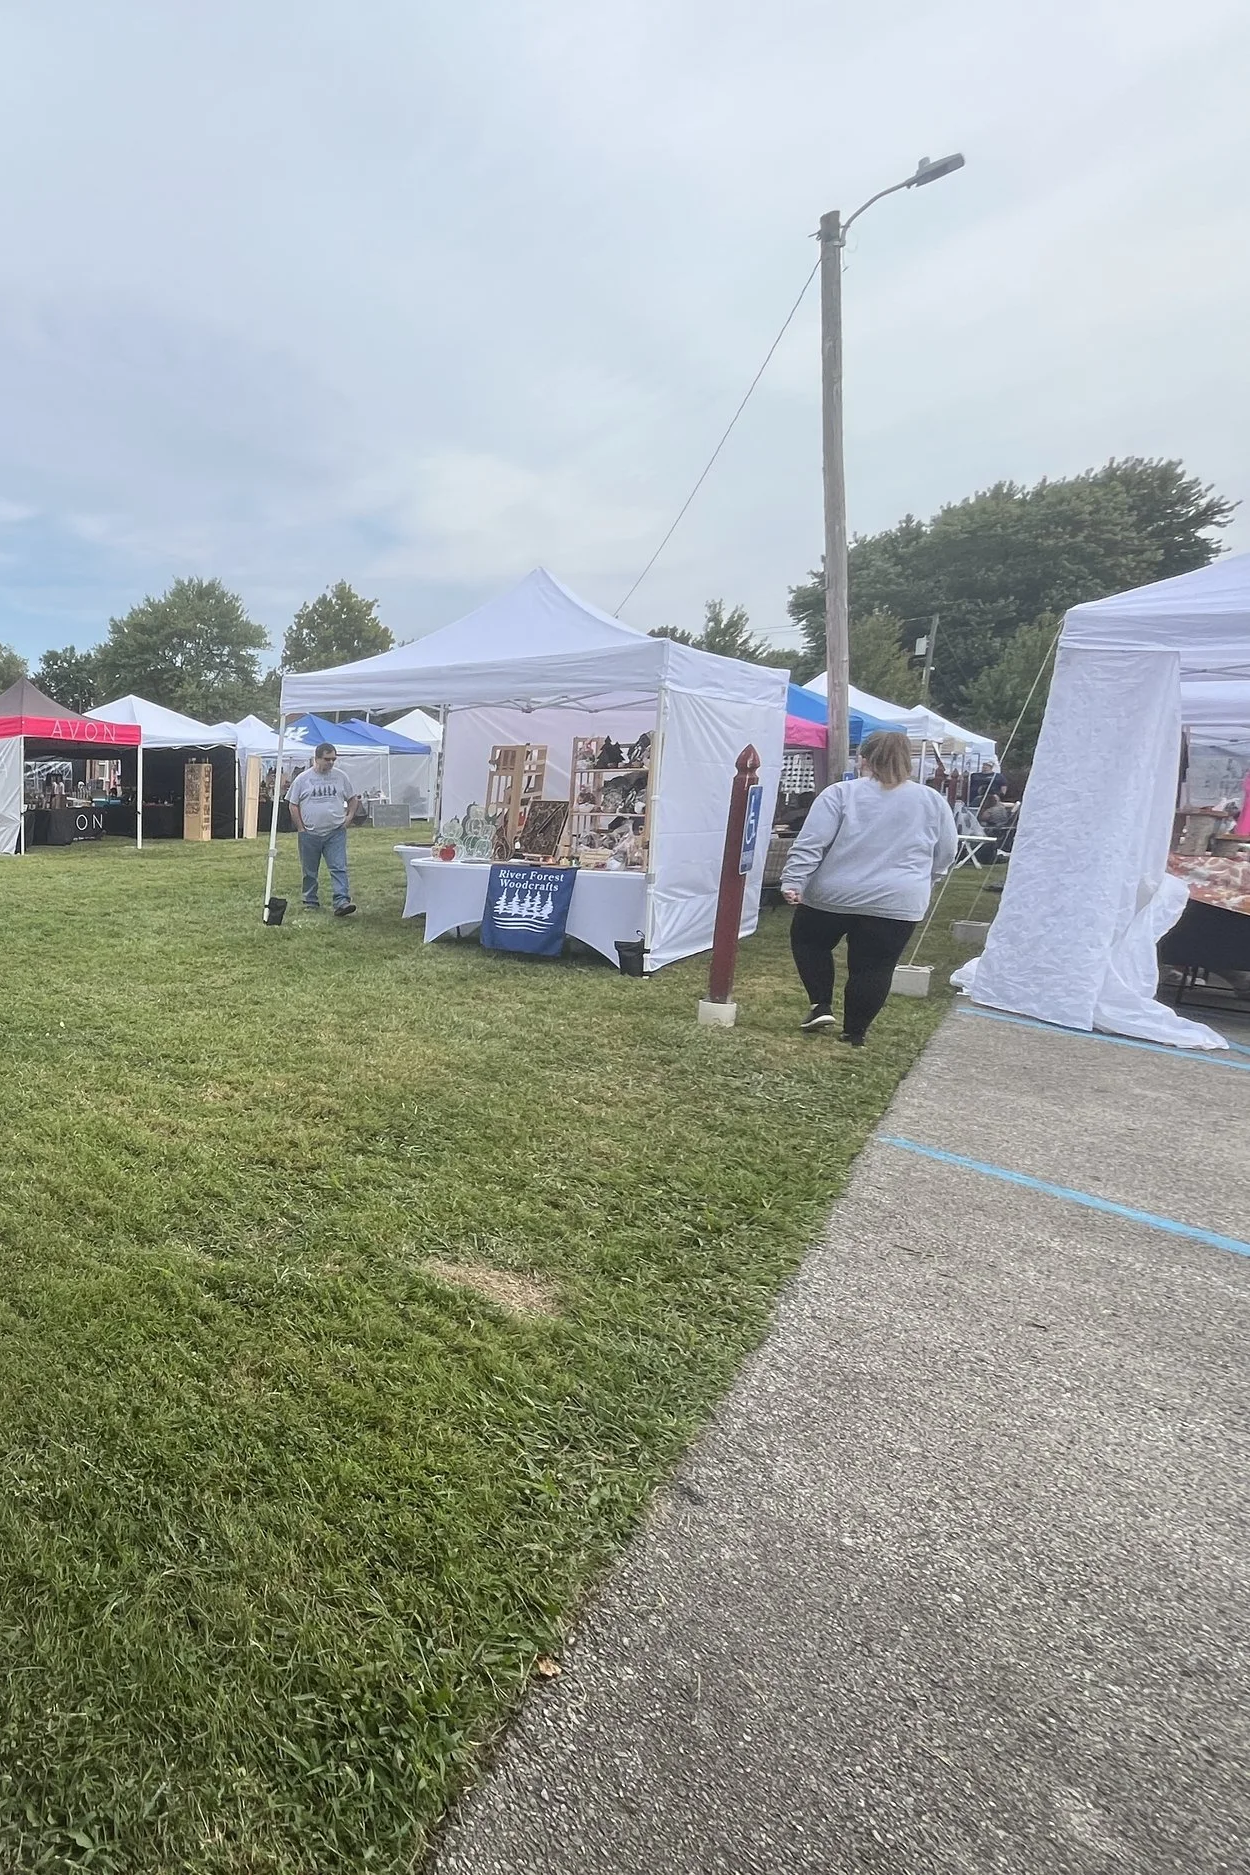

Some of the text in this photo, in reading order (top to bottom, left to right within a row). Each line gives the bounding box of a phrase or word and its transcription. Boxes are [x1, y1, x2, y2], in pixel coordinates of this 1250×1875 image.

[51, 719, 117, 742] AVON
[498, 869, 565, 882] River Forest
[500, 879, 559, 891] Woodcrafts
